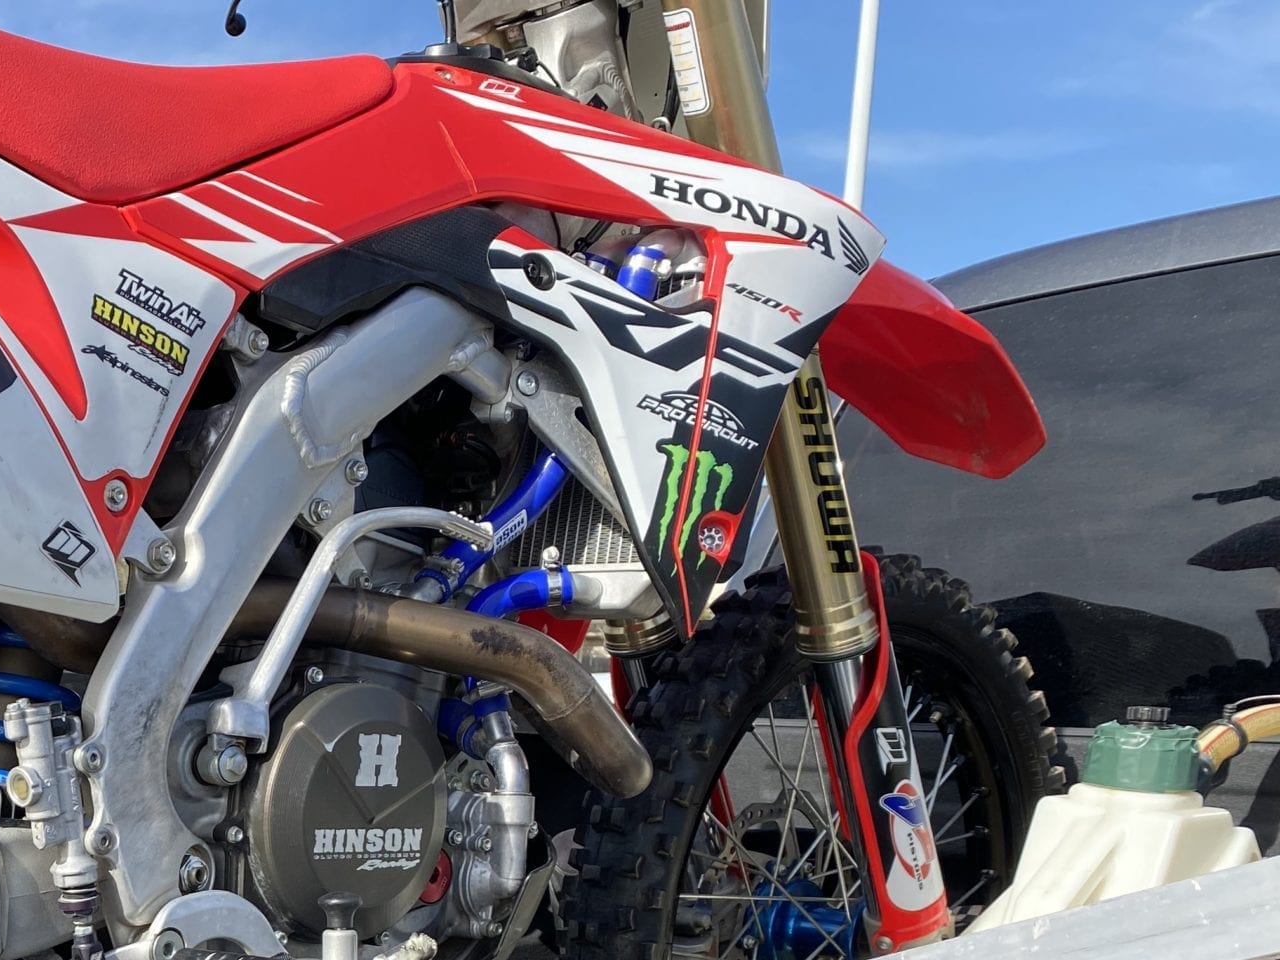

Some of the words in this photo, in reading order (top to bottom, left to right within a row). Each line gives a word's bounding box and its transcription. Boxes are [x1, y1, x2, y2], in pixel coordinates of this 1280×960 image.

[649, 173, 836, 261] HONDA
[119, 269, 172, 315] Twin
[169, 303, 206, 331] Air
[725, 282, 803, 324] 450R
[93, 297, 189, 366] HINSON
[639, 396, 687, 422] PRO
[686, 414, 760, 451] CIRCUIT
[794, 376, 859, 574] SHOWA
[355, 733, 402, 787] H
[313, 828, 423, 853] HINSON
